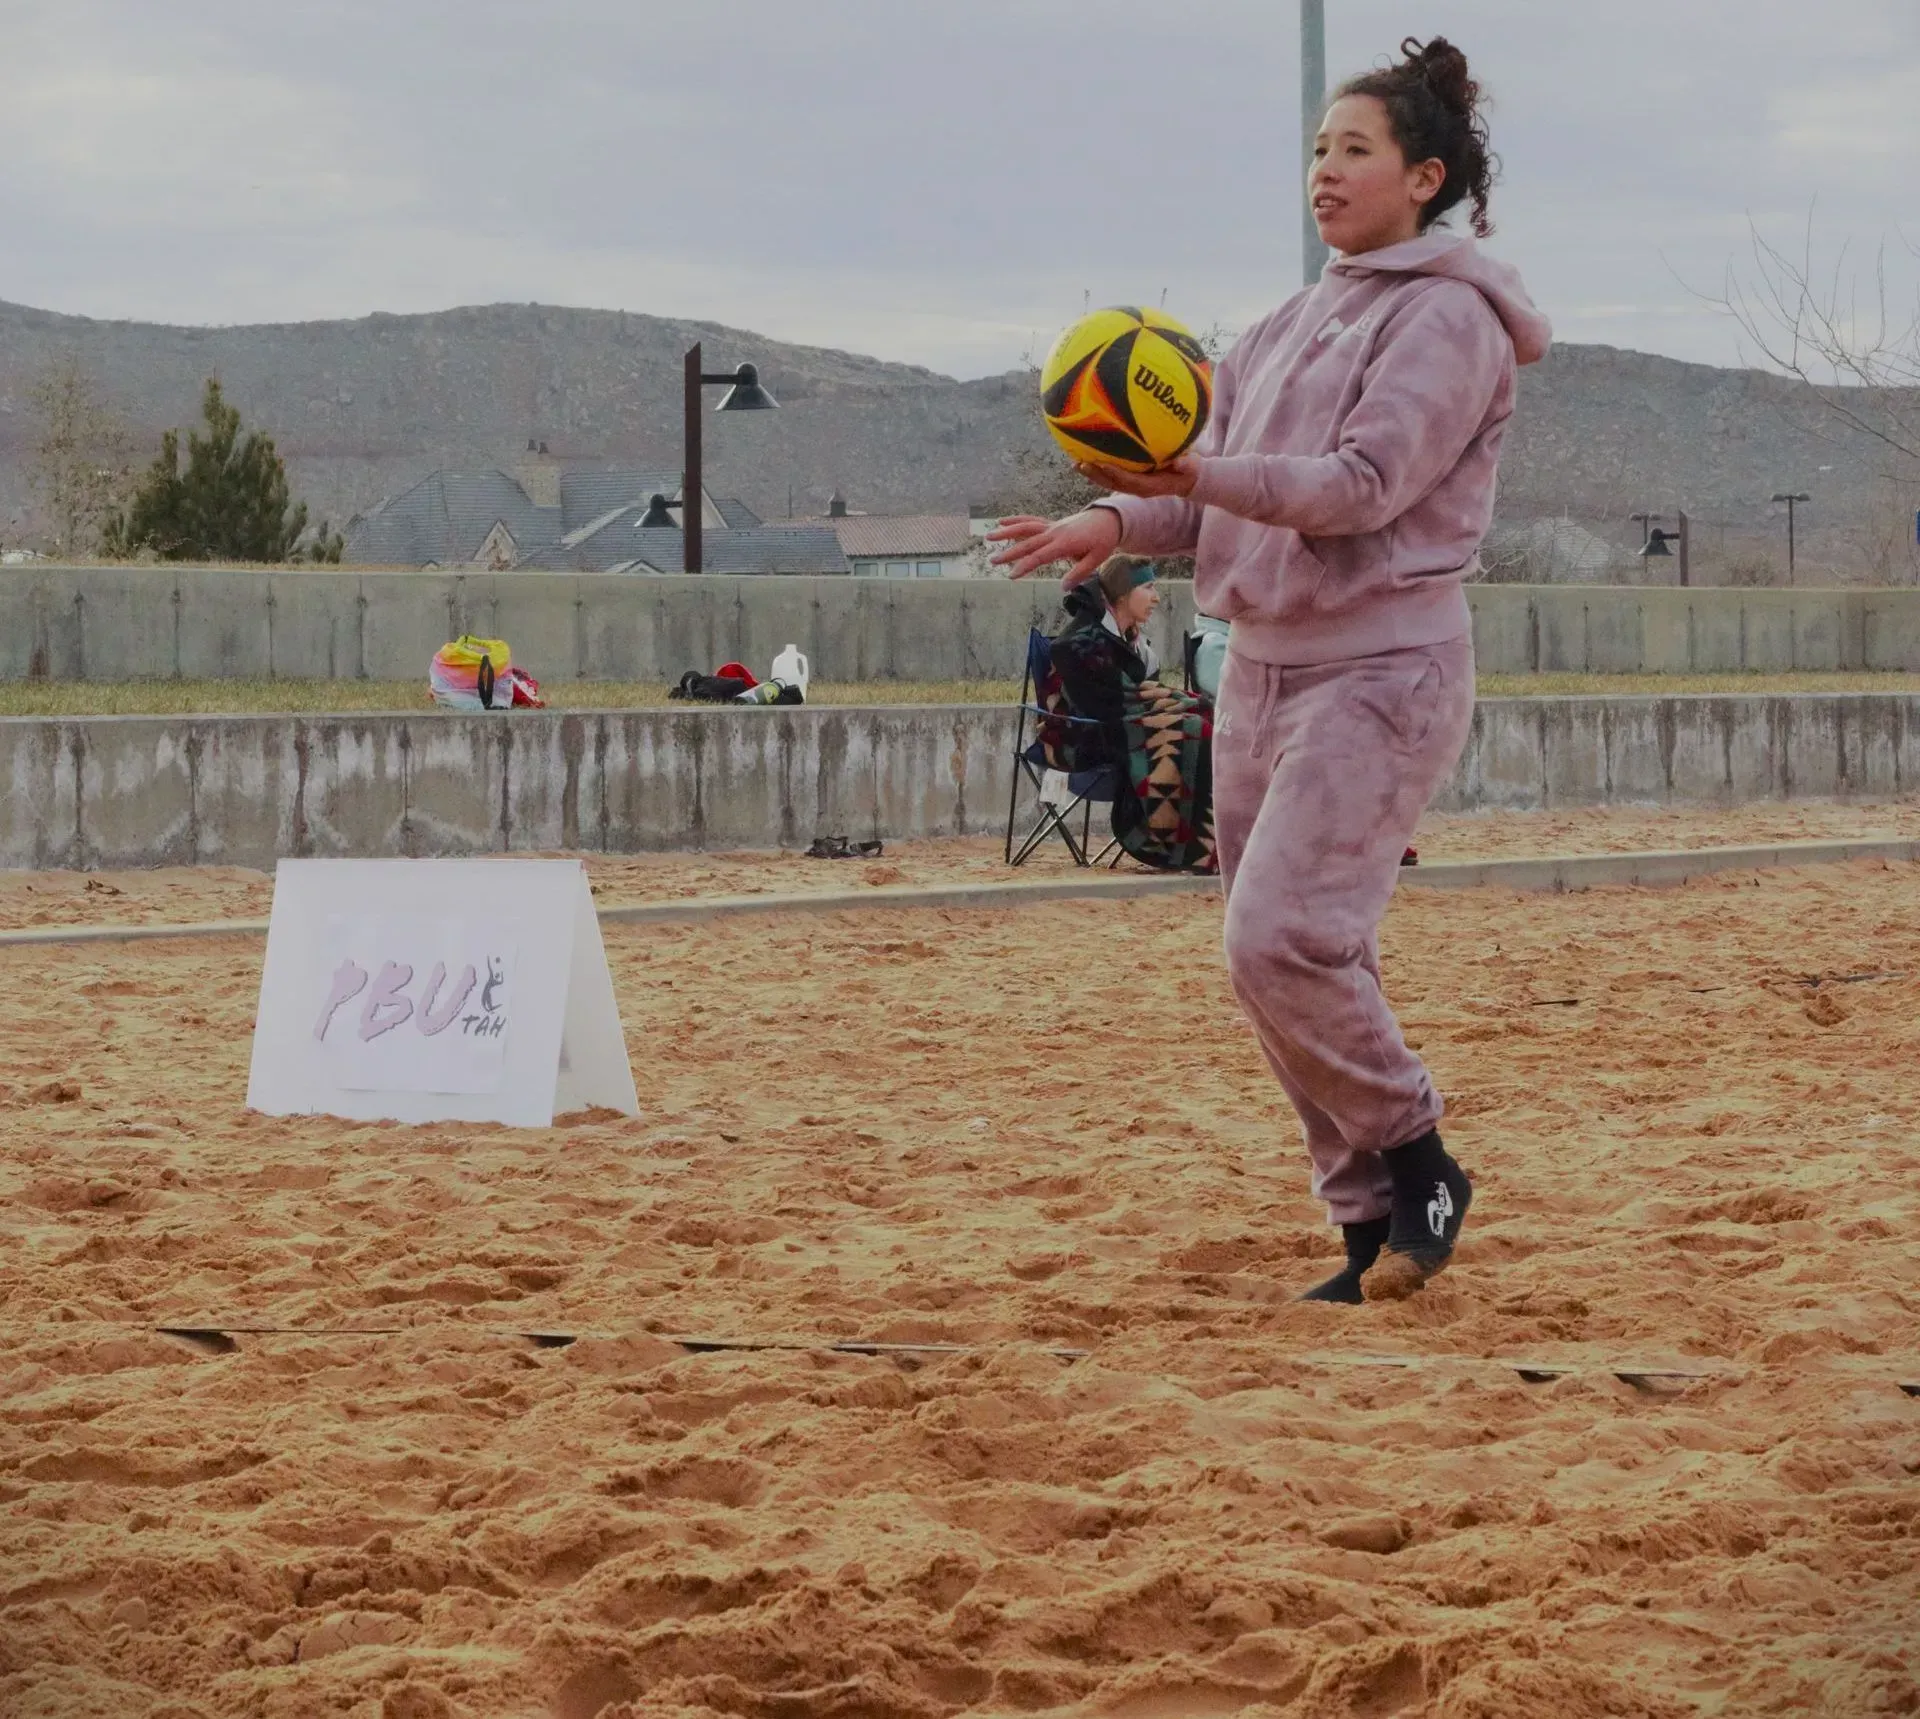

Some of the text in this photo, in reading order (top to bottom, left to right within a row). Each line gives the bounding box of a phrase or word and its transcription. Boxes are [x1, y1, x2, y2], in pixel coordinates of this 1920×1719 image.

[1134, 364, 1191, 425] Wilson
[314, 957, 477, 1043] PBU
[461, 1014, 506, 1038] TAH
